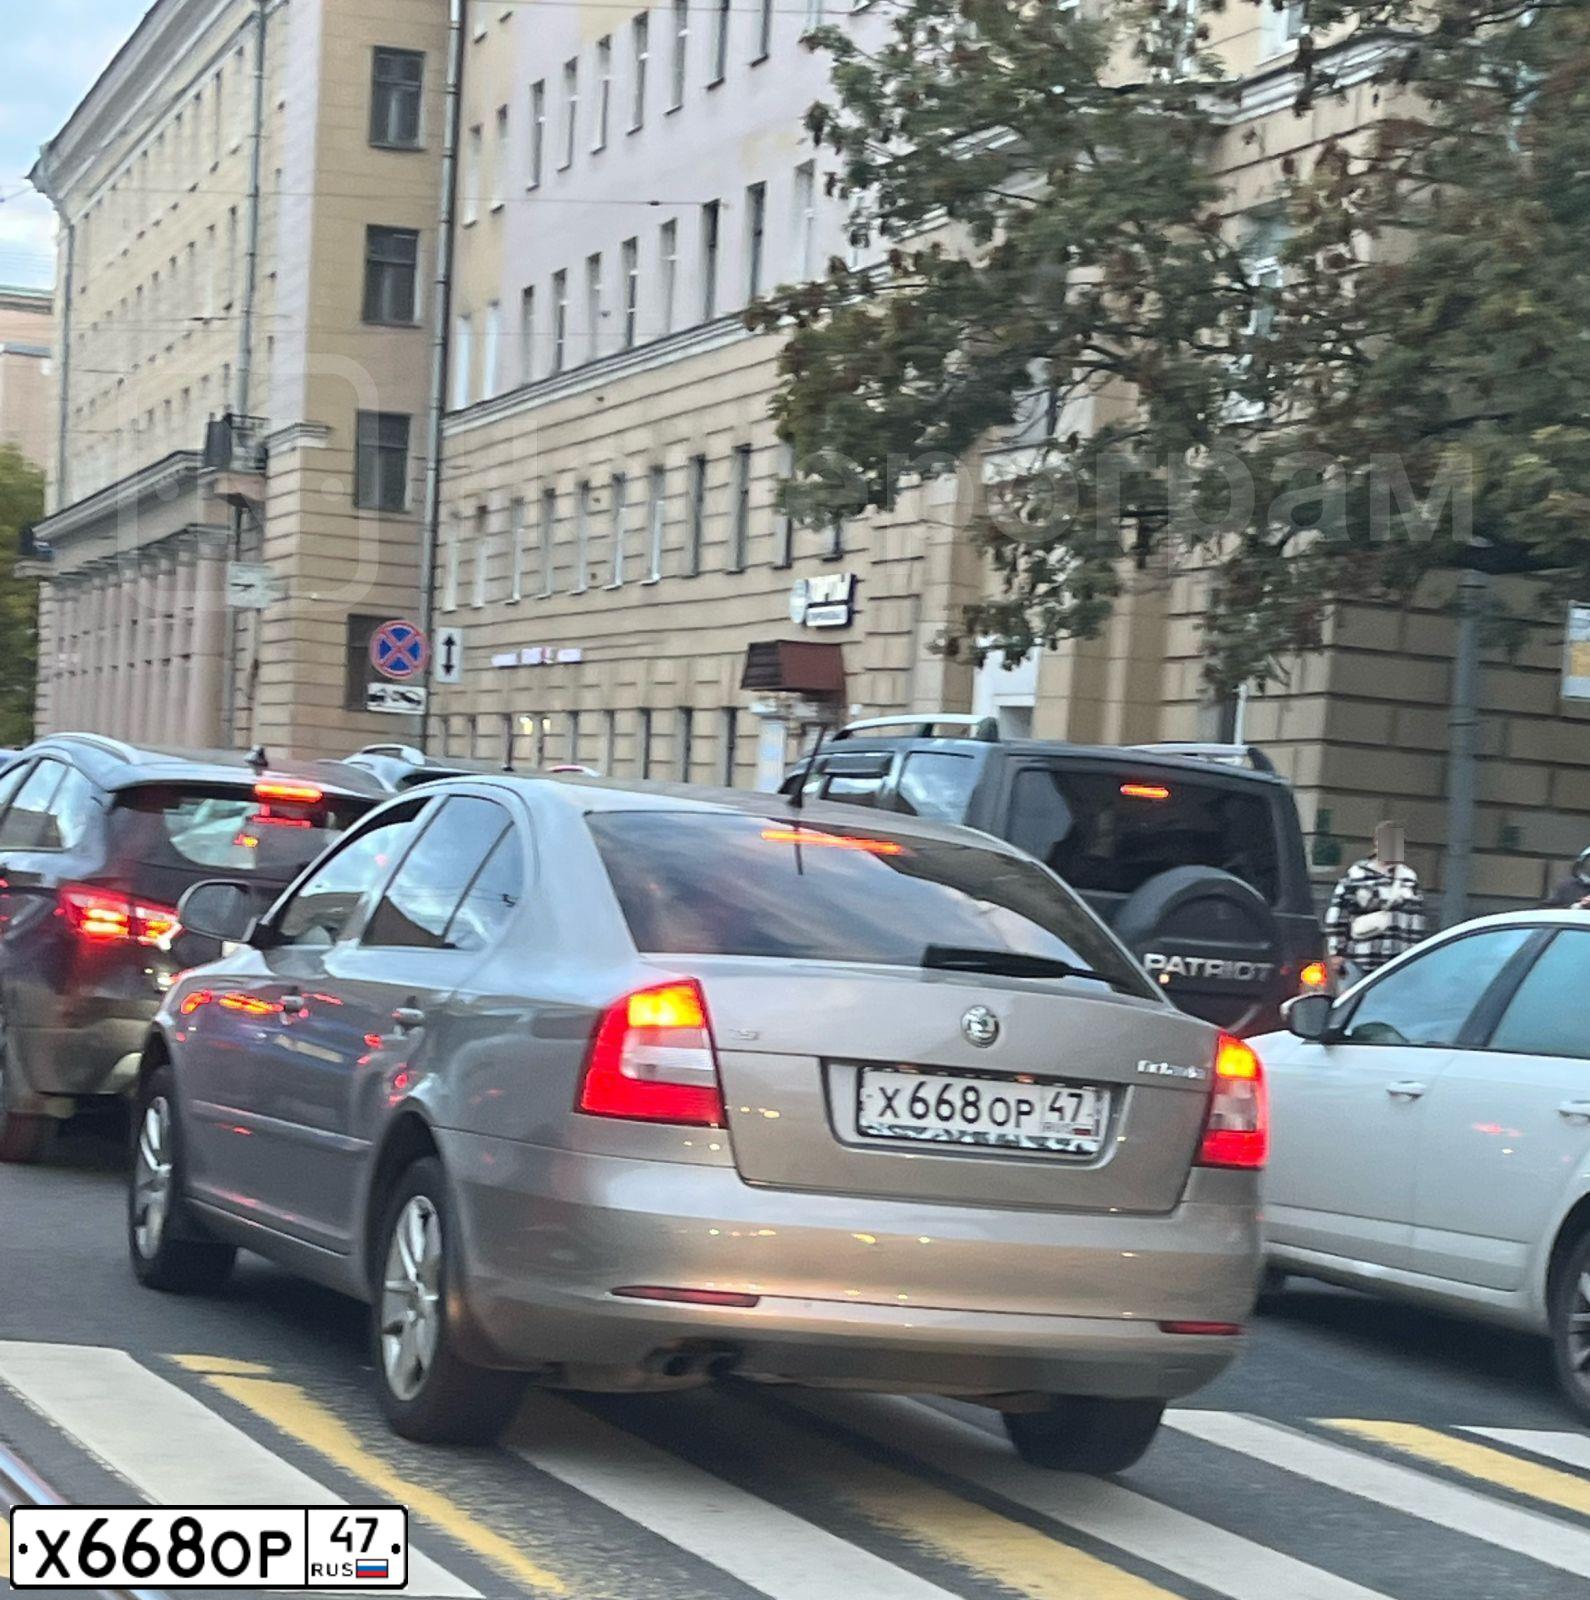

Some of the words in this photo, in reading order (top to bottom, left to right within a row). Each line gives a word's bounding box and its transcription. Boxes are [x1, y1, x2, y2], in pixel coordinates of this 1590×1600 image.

[1143, 953, 1274, 982] PATRIOT
[877, 1080, 1035, 1128] Х668ОР
[1048, 1090, 1084, 1122] 47
